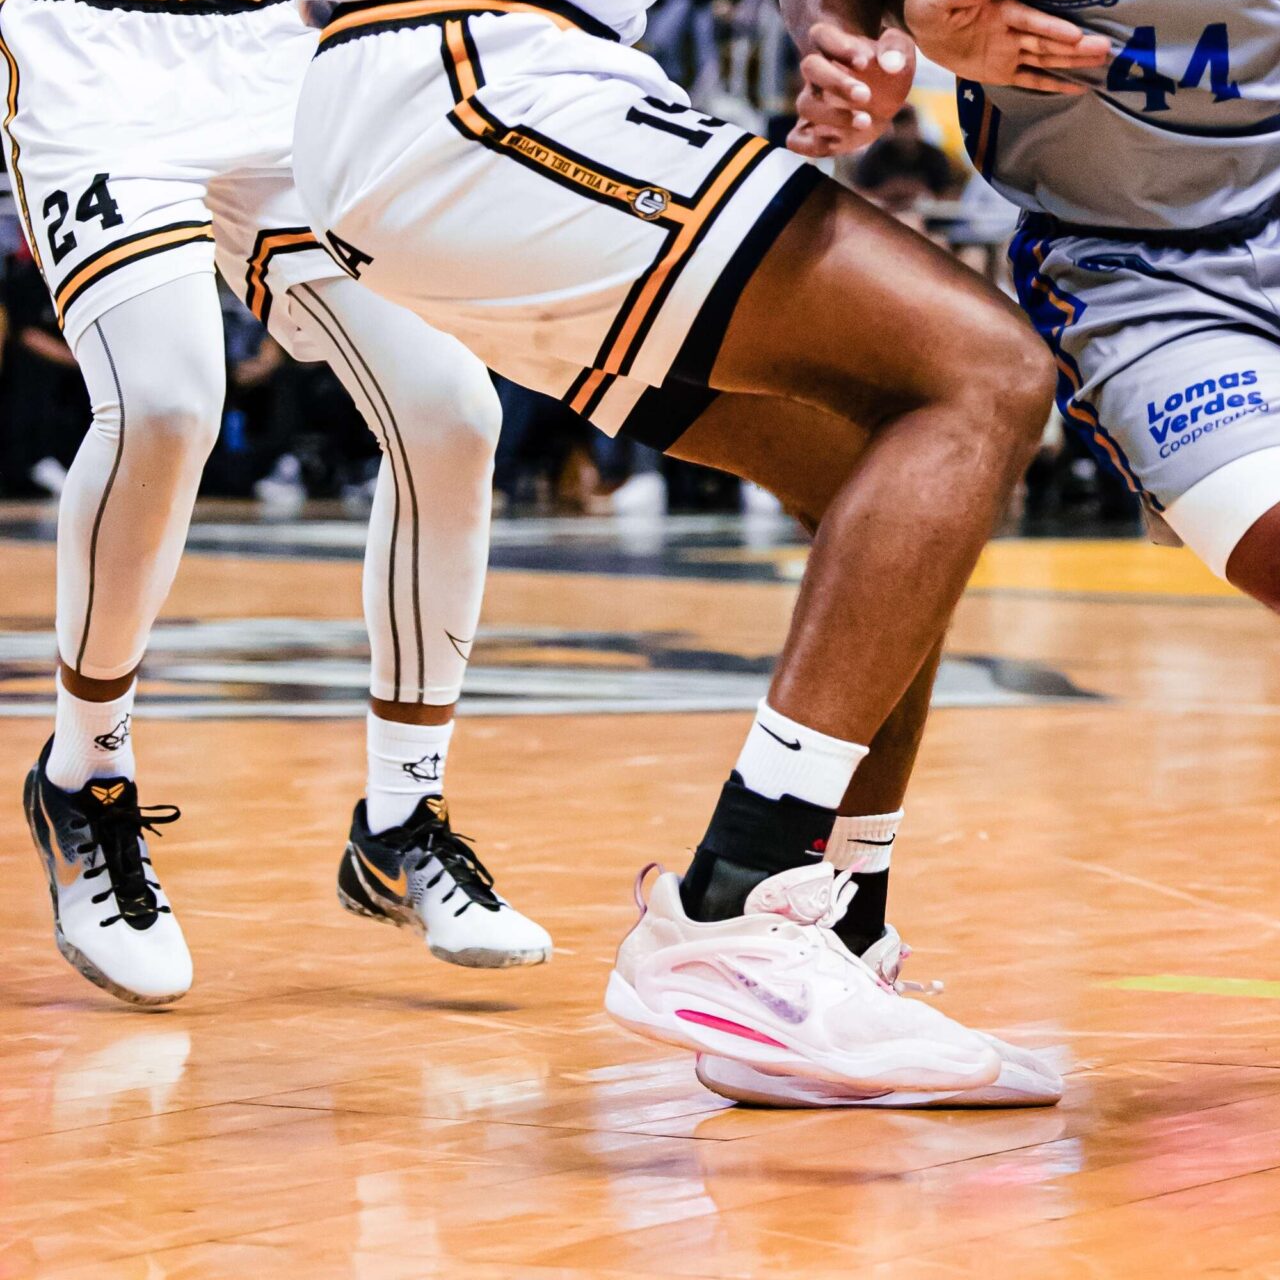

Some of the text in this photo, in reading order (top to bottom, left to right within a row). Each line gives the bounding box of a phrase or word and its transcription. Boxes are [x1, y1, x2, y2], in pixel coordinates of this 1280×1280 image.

[1105, 23, 1242, 112] 44
[572, 166, 604, 190] VILLA
[604, 182, 622, 195] LA
[43, 172, 124, 266] 24
[1147, 370, 1258, 425] Lomas
[1149, 391, 1265, 445] Verdes
